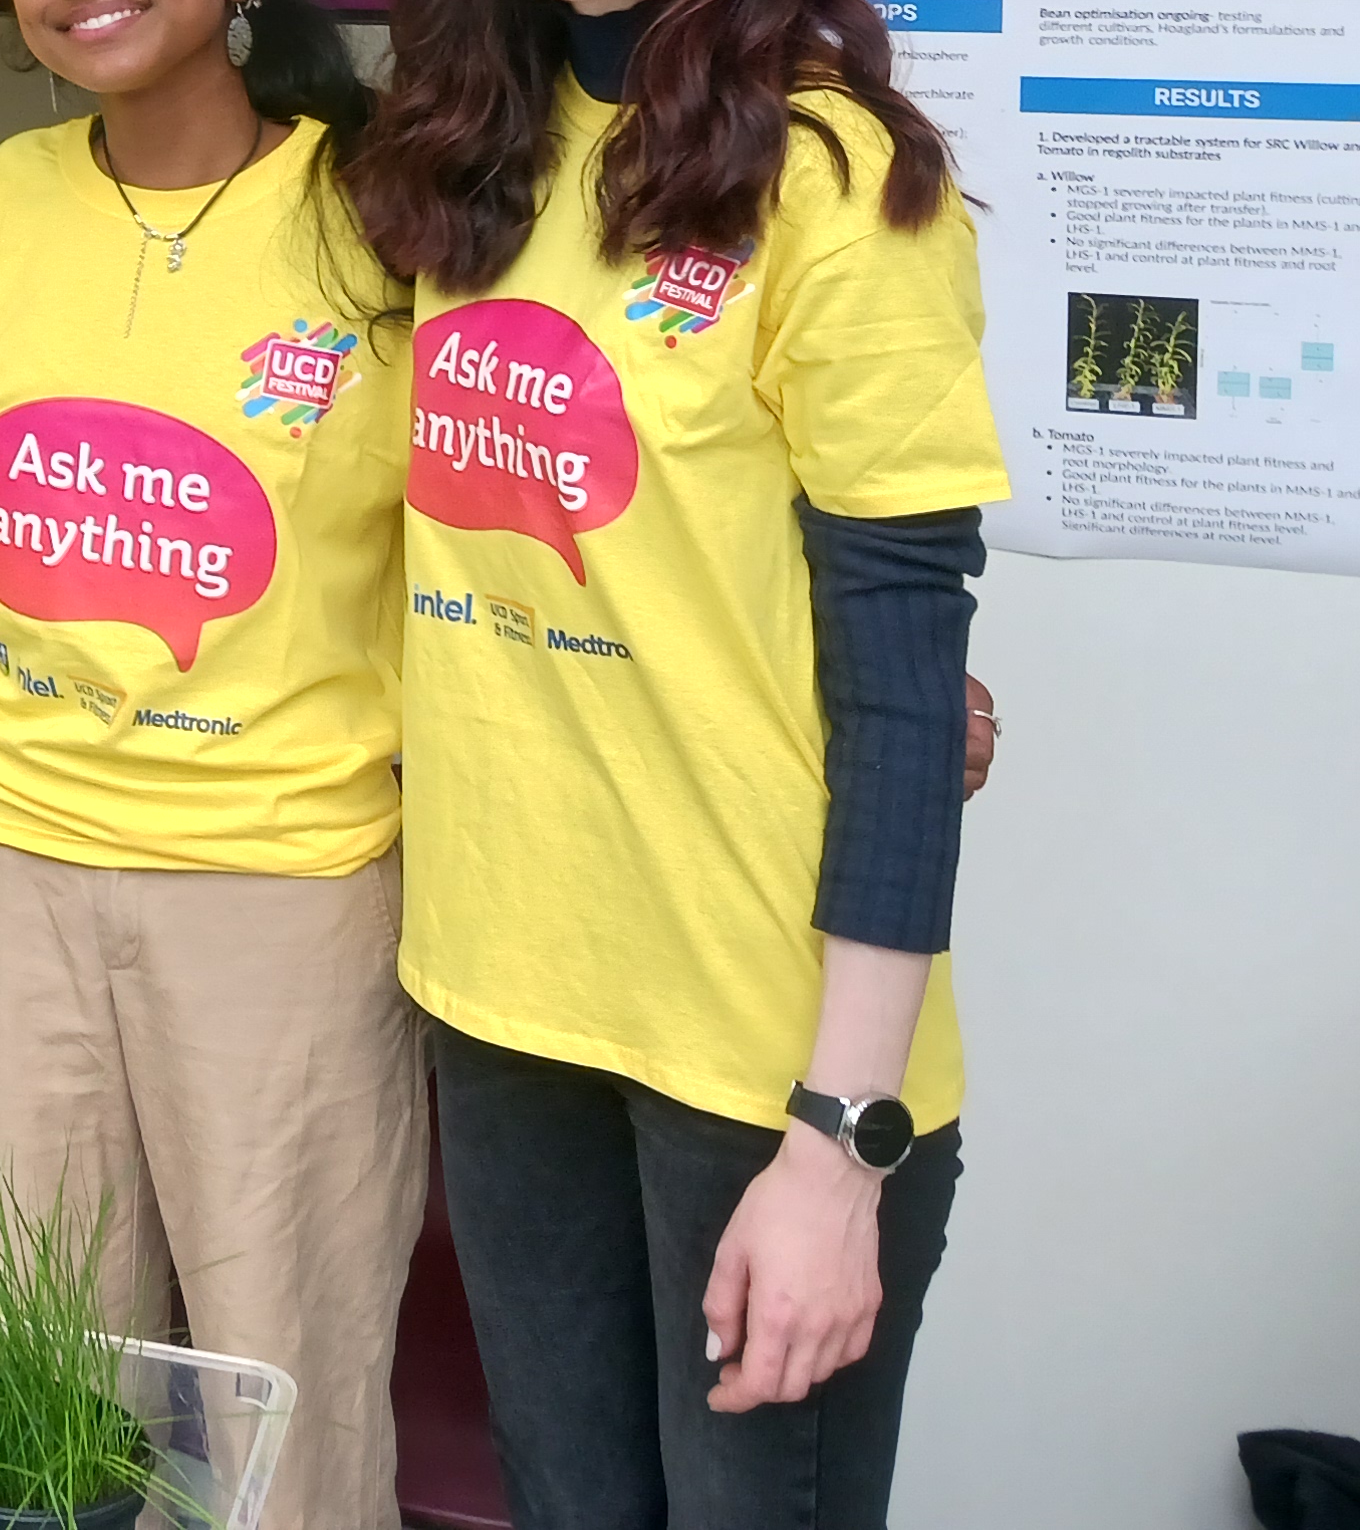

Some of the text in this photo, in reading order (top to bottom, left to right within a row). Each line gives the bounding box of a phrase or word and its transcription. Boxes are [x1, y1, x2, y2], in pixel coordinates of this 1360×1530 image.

[1154, 87, 1261, 109] RESULTS
[1052, 132, 1120, 145] Developed
[1134, 135, 1190, 147] tractable
[1243, 138, 1262, 149] for
[668, 257, 726, 291] UCD
[659, 281, 714, 310] FESTIVAL
[271, 352, 335, 386] UCD
[429, 330, 573, 414] Ask me
[268, 375, 331, 402] FESTIVAL
[8, 432, 211, 513] Ask me
[411, 405, 590, 512] anything
[547, 628, 632, 661] Medtro
[17, 660, 64, 699] ntel.
[132, 709, 243, 736] Medtronic
